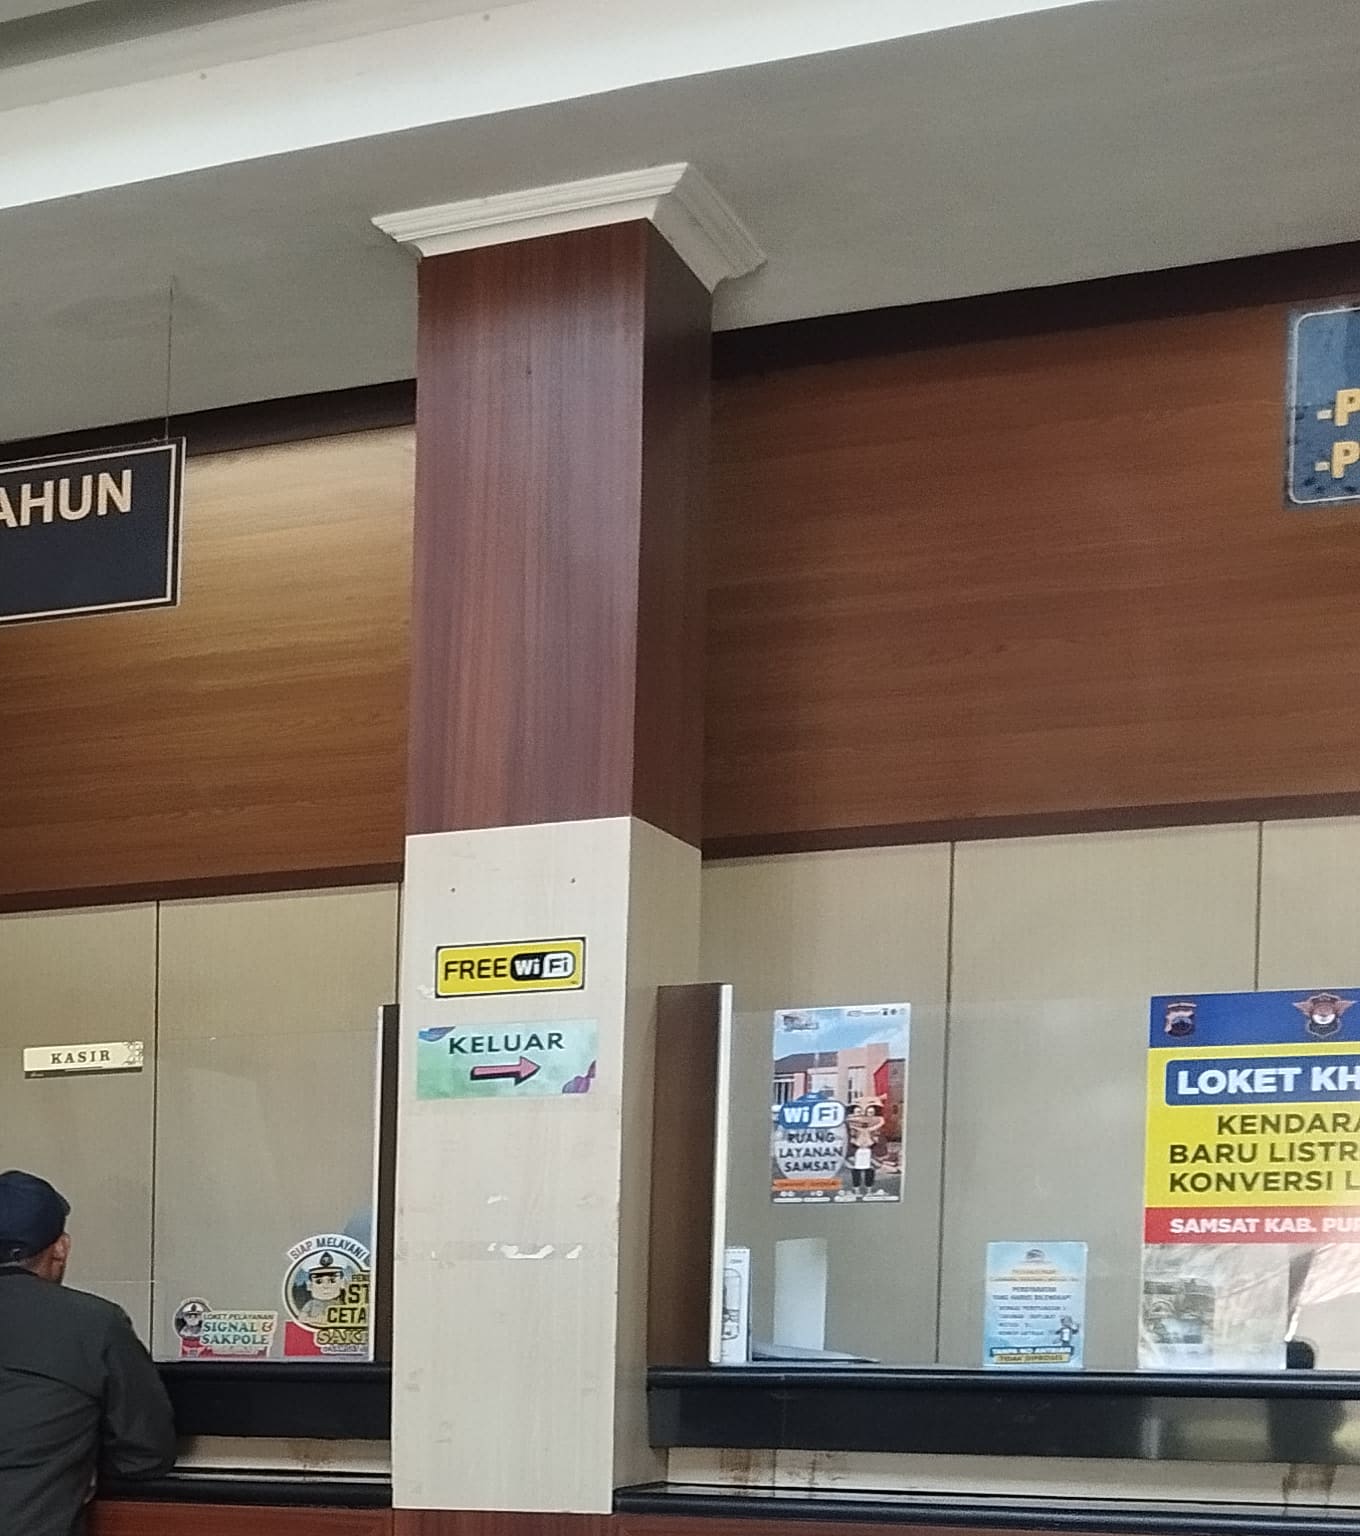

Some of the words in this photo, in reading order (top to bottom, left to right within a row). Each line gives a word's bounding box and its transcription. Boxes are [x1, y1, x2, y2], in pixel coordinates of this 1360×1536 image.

[444, 957, 508, 981] FREE
[514, 957, 570, 977] WiFi
[448, 1032, 565, 1054] KELUAR
[51, 1049, 110, 1064] KASIR
[1177, 1067, 1302, 1095] LOKET
[783, 1106, 839, 1124] WiFi
[788, 1132, 836, 1143] RUANG
[779, 1145, 843, 1158] LAYANAN
[1169, 1142, 1258, 1164] BARU
[1269, 1140, 1360, 1163] LISTR
[784, 1160, 836, 1172] SAMSAT
[1169, 1170, 1332, 1193] KONVERSI
[1170, 1217, 1258, 1234] SAMSAT
[1264, 1217, 1316, 1233] KAB.
[290, 1240, 313, 1260] SIAP
[316, 1237, 366, 1260] MELAYANI
[203, 1321, 257, 1333] SIGNAL
[262, 1321, 273, 1332] &
[201, 1334, 269, 1345] SAKPOLE
